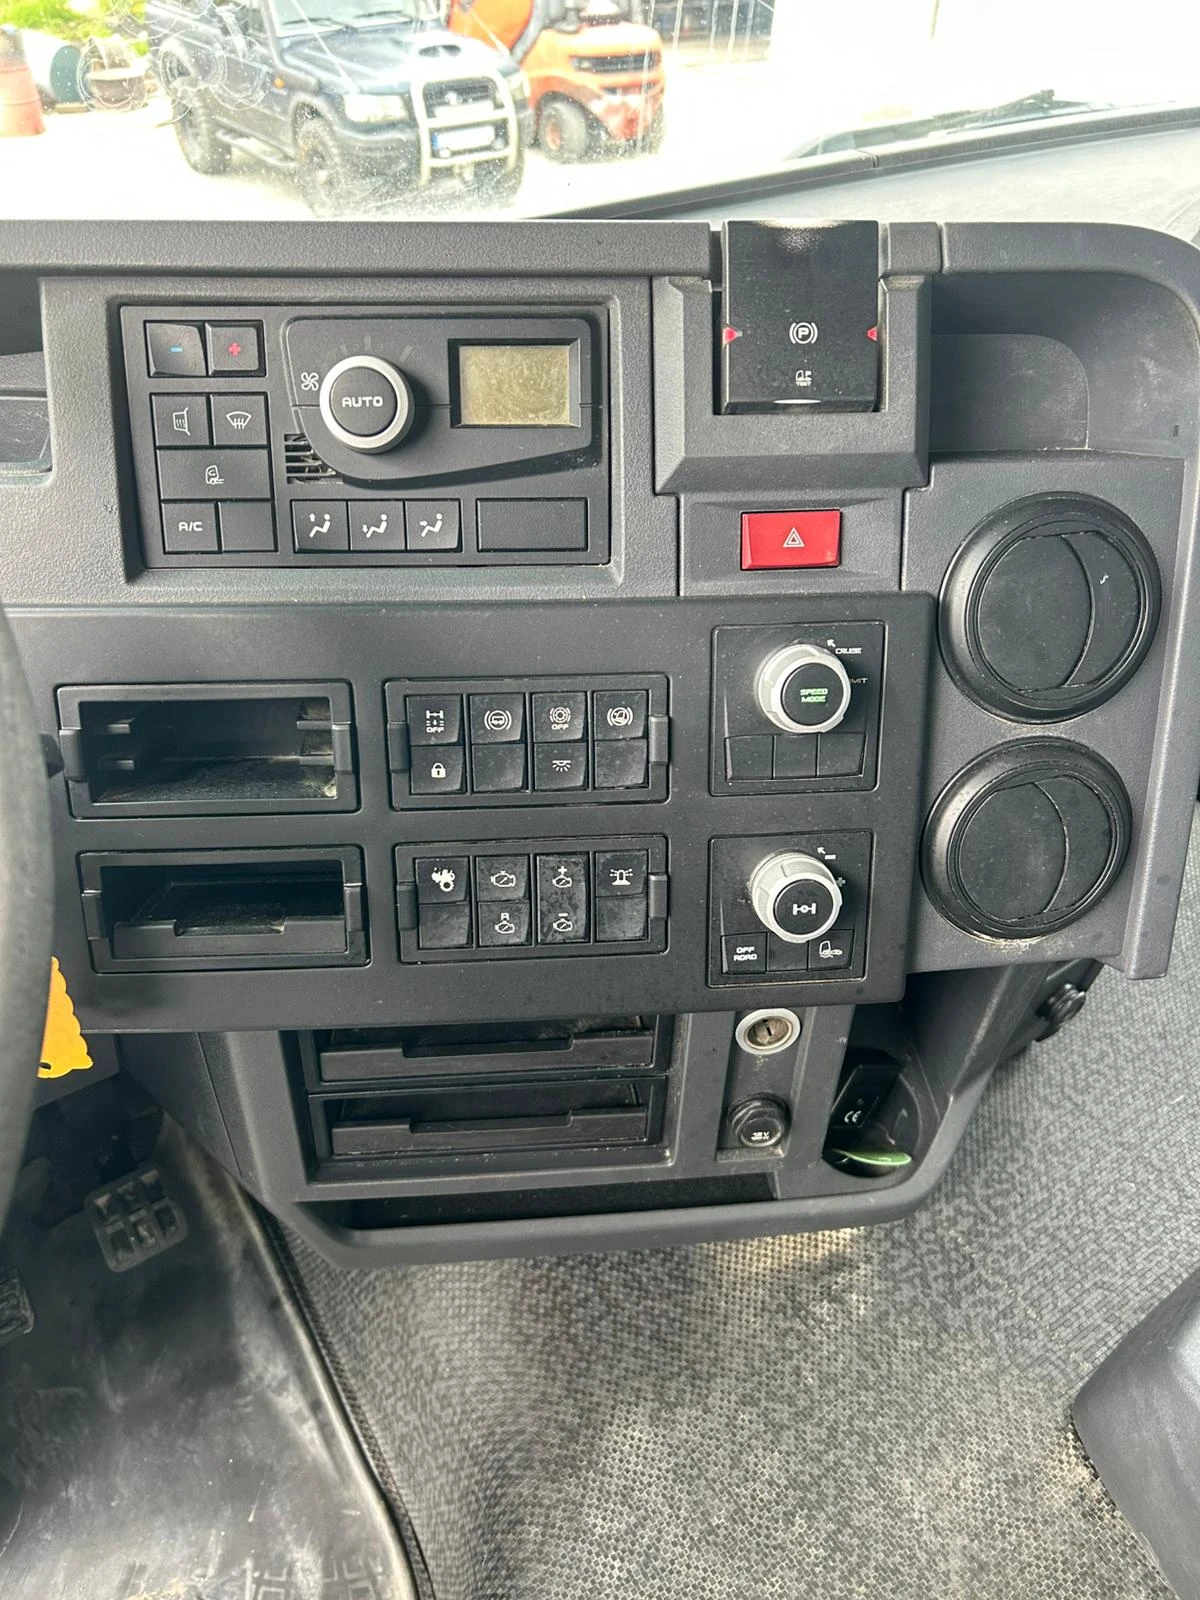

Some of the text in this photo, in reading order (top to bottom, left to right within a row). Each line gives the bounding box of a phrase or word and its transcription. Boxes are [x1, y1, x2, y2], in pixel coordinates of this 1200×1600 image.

[342, 396, 383, 408] AUTO
[178, 521, 203, 532] A/C
[800, 688, 828, 696] SPEED
[801, 695, 826, 703] MODE
[736, 946, 755, 954] OFF
[733, 953, 758, 962] ROAD
